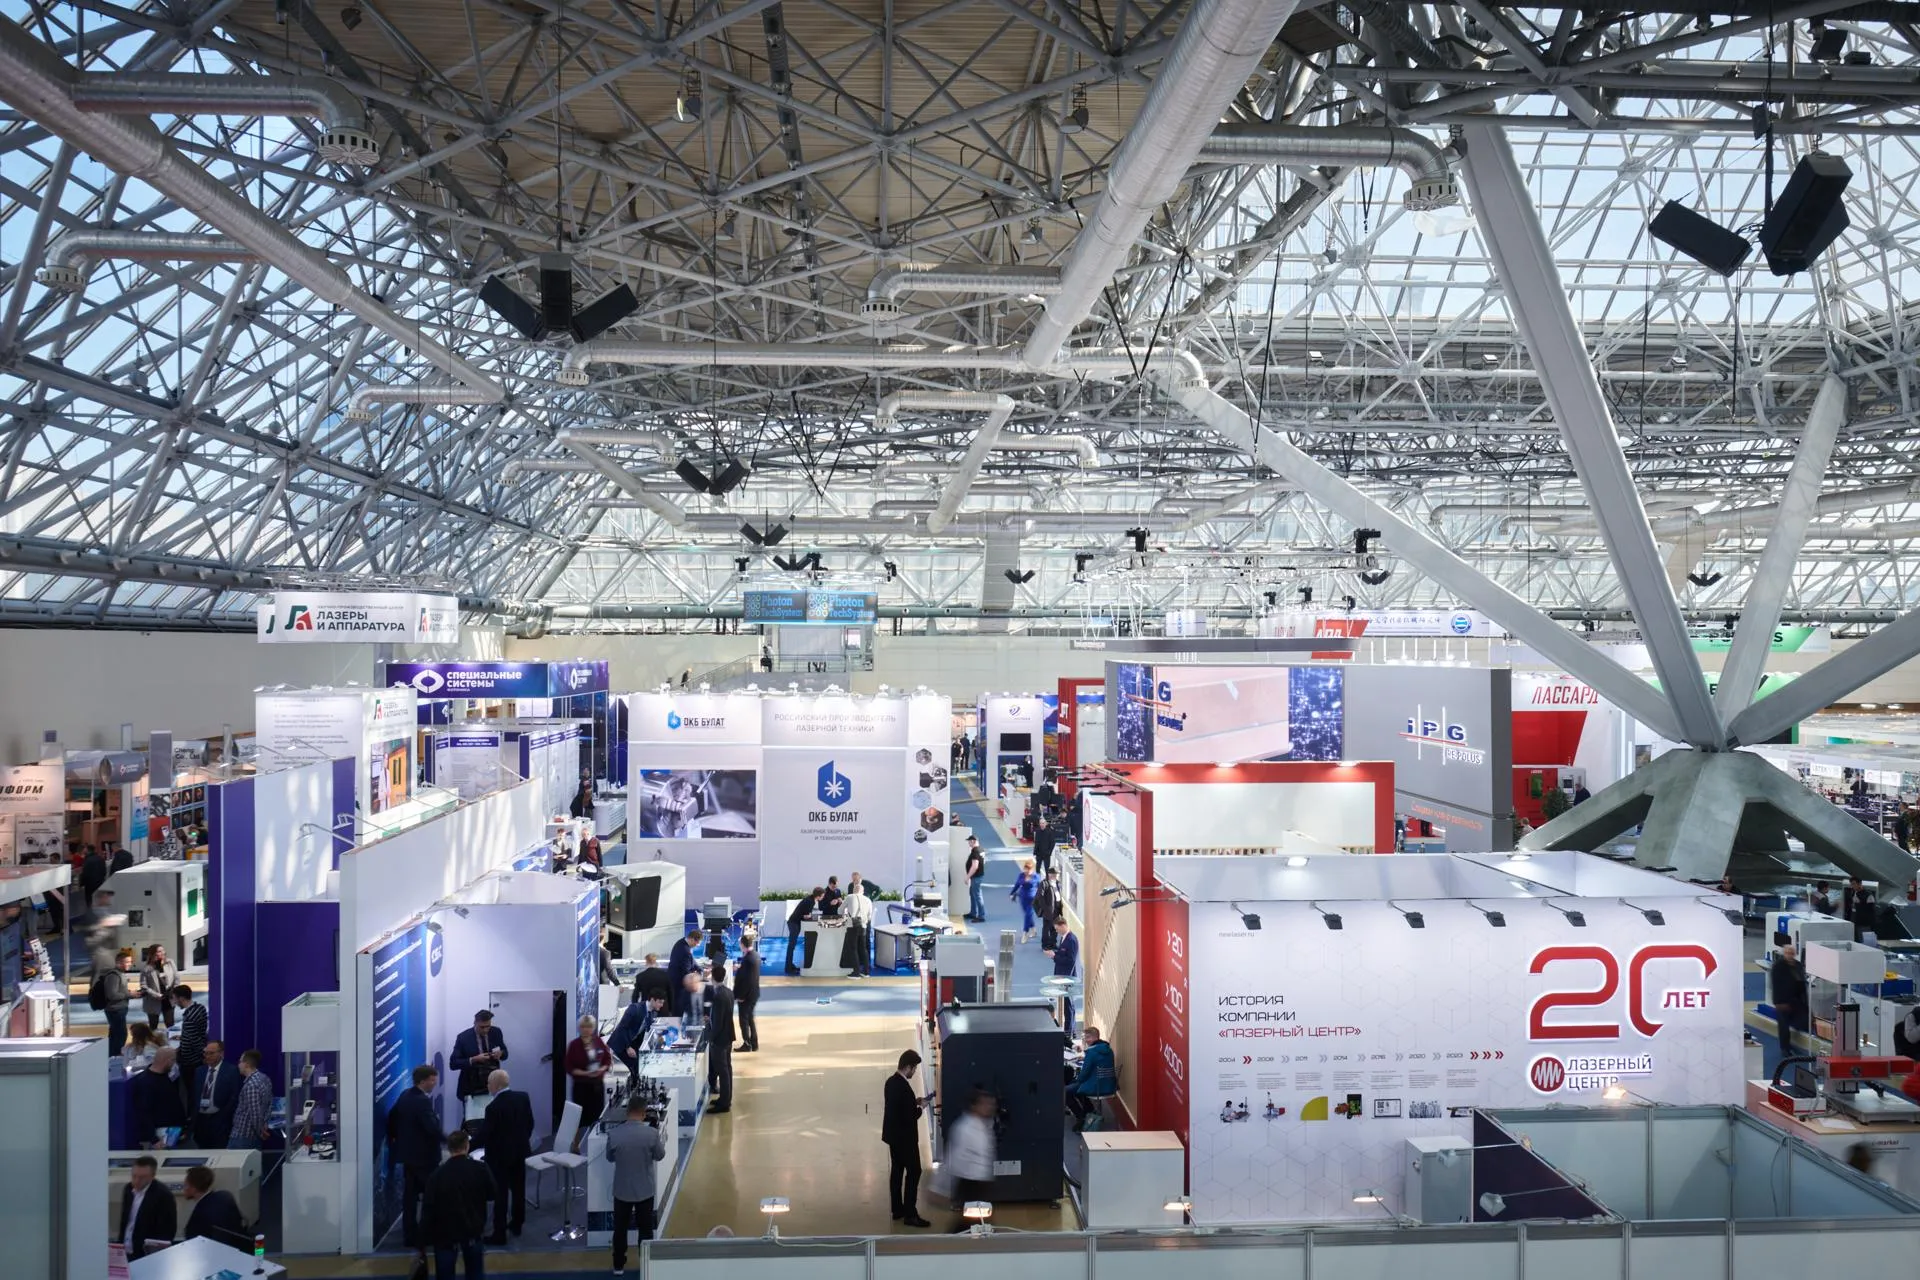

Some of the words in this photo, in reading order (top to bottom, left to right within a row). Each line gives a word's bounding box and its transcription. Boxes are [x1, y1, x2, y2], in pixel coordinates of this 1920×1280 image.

[762, 594, 793, 606] Photon
[828, 595, 865, 607] Photon
[316, 611, 368, 620] ЛАЗЕРЫ
[762, 607, 804, 619] TechSystem
[828, 608, 875, 620] TechSystem
[316, 622, 325, 631] И
[328, 622, 406, 632] АППАРАТУРА
[446, 671, 523, 681] специальные
[446, 679, 495, 688] системы
[1531, 686, 1599, 705] ЛАССАРД
[683, 717, 699, 728] ОКБ
[701, 717, 726, 728] БУЛАТ
[795, 723, 838, 733] ЛАЗЕРНОЙ
[839, 724, 875, 733] ТЕХНИКИ
[808, 811, 827, 822] ОКБ
[829, 811, 859, 822] БУЛАТ
[1529, 944, 1718, 1040] 20
[1218, 995, 1284, 1006] ИСТОРИЯ
[1663, 991, 1710, 1008] ЛЕТ
[1218, 1011, 1296, 1022] КОМПАНИИ
[1218, 1025, 1304, 1038] «ЛАЗЕРНЫЙ
[1308, 1026, 1362, 1038] ЦЕНТР»
[1568, 1075, 1618, 1091] ЦЕНТР
